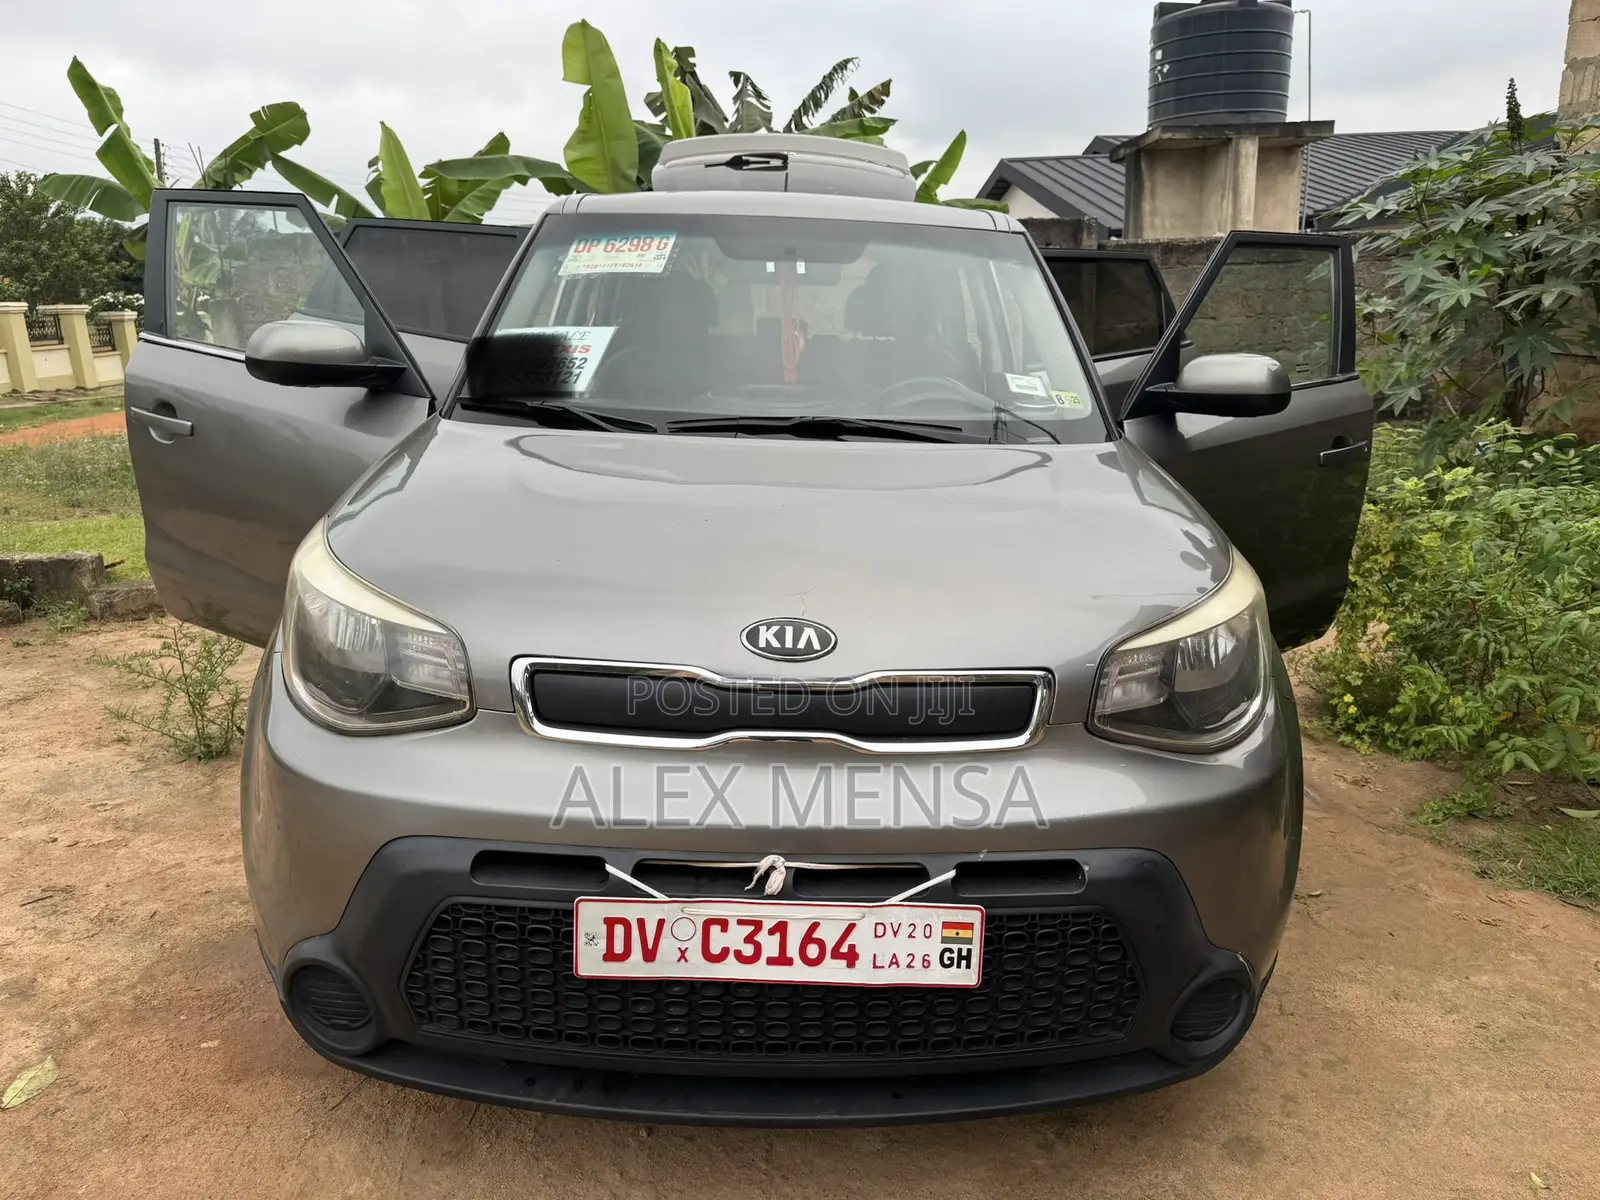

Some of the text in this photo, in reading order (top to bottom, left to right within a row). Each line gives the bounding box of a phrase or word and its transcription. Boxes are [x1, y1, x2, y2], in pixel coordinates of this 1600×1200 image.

[573, 236, 670, 253] DP 6298 G
[551, 331, 591, 341] SALE
[758, 625, 821, 650] KIA
[602, 916, 666, 963] DV
[701, 917, 860, 969] C3164
[939, 947, 973, 969] GH
